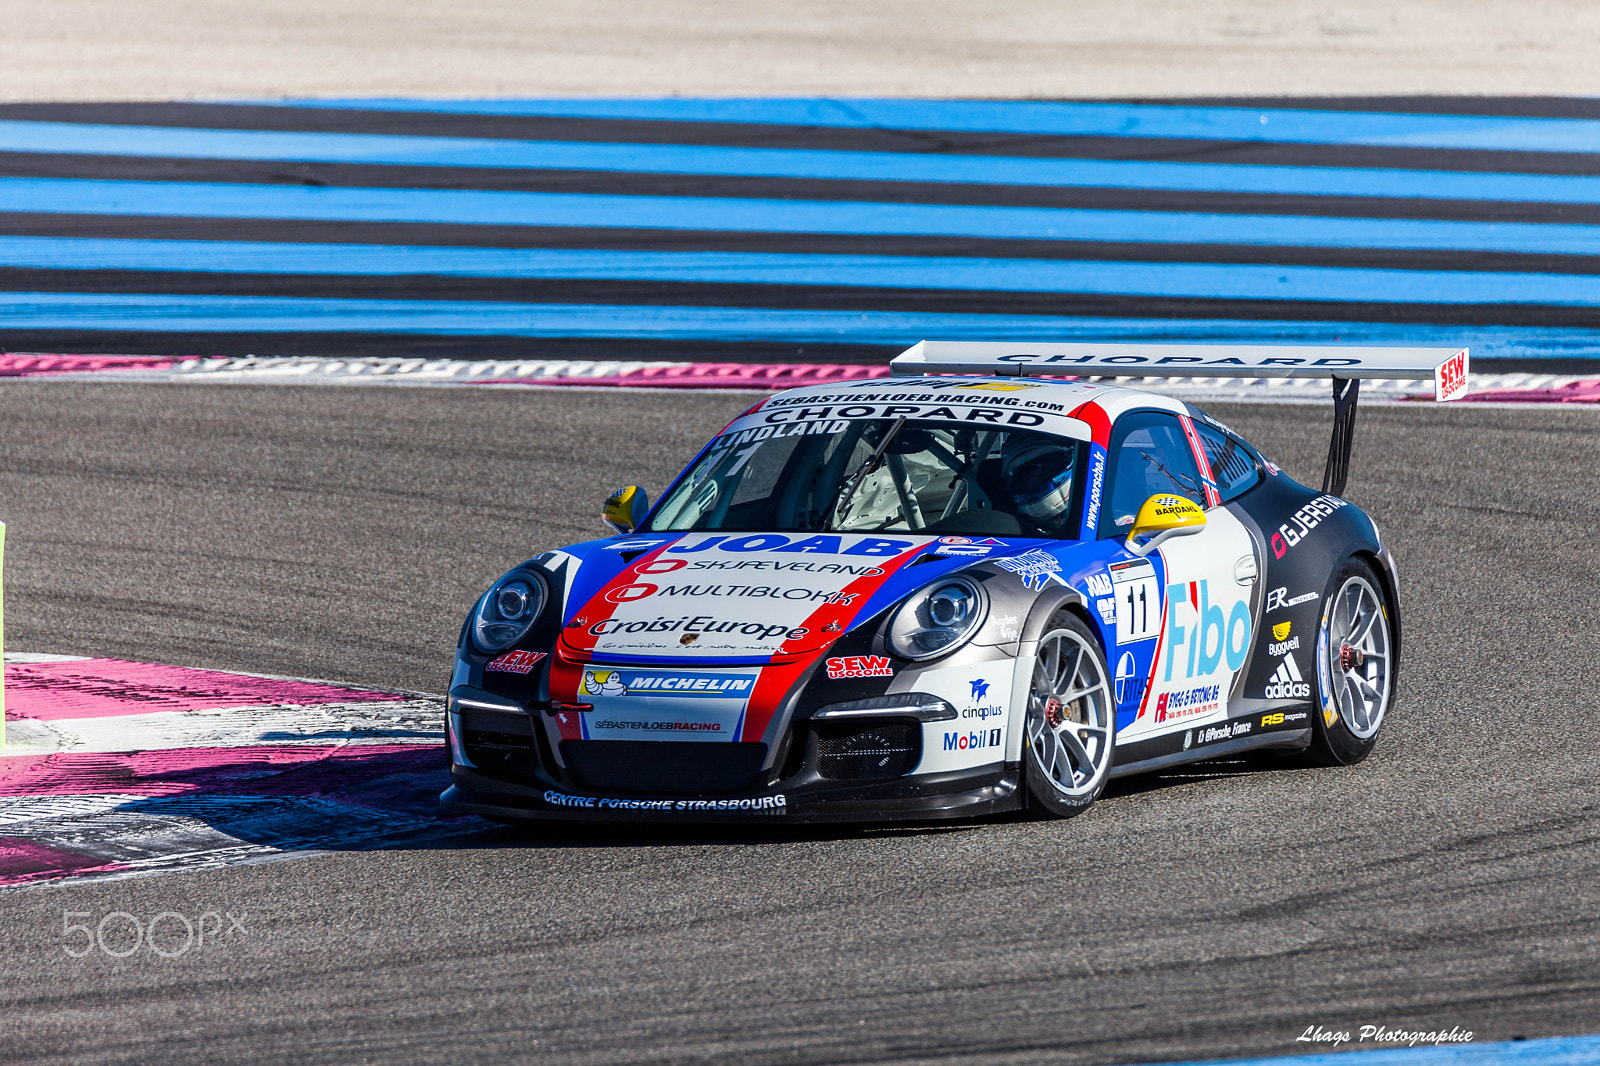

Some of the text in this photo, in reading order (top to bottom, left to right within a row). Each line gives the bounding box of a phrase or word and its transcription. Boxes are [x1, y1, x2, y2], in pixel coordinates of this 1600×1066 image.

[997, 354, 1363, 366] CHOPARD
[1440, 351, 1465, 389] SEW
[764, 406, 1046, 427] CHOPARD
[711, 420, 851, 451] LINDLAND
[1086, 450, 1105, 530] www.porsche.fr
[1154, 505, 1199, 516] BARDAHL
[666, 533, 914, 556] JOAB
[686, 559, 885, 578] SKJÆVELAND
[657, 584, 862, 606] MULTIBLOKK
[1084, 573, 1114, 598] JOAB
[1127, 584, 1147, 635] 11
[1265, 586, 1289, 614] ER
[588, 616, 809, 641] CroisiEurope
[1164, 579, 1251, 682] Fibo
[1268, 635, 1300, 656] Byggvell
[491, 650, 548, 667] SEW
[826, 655, 891, 672] SEW
[629, 677, 752, 690] MICHELIN
[828, 667, 893, 679] USOCOME
[1264, 681, 1310, 699] adidas
[962, 704, 1002, 721] cinqplus
[1261, 711, 1307, 728] RS magazine
[943, 729, 987, 751] Mobil
[1205, 721, 1252, 743] @Porsche_France
[543, 790, 787, 810] CENTRE PORSCHE STRASBOURG
